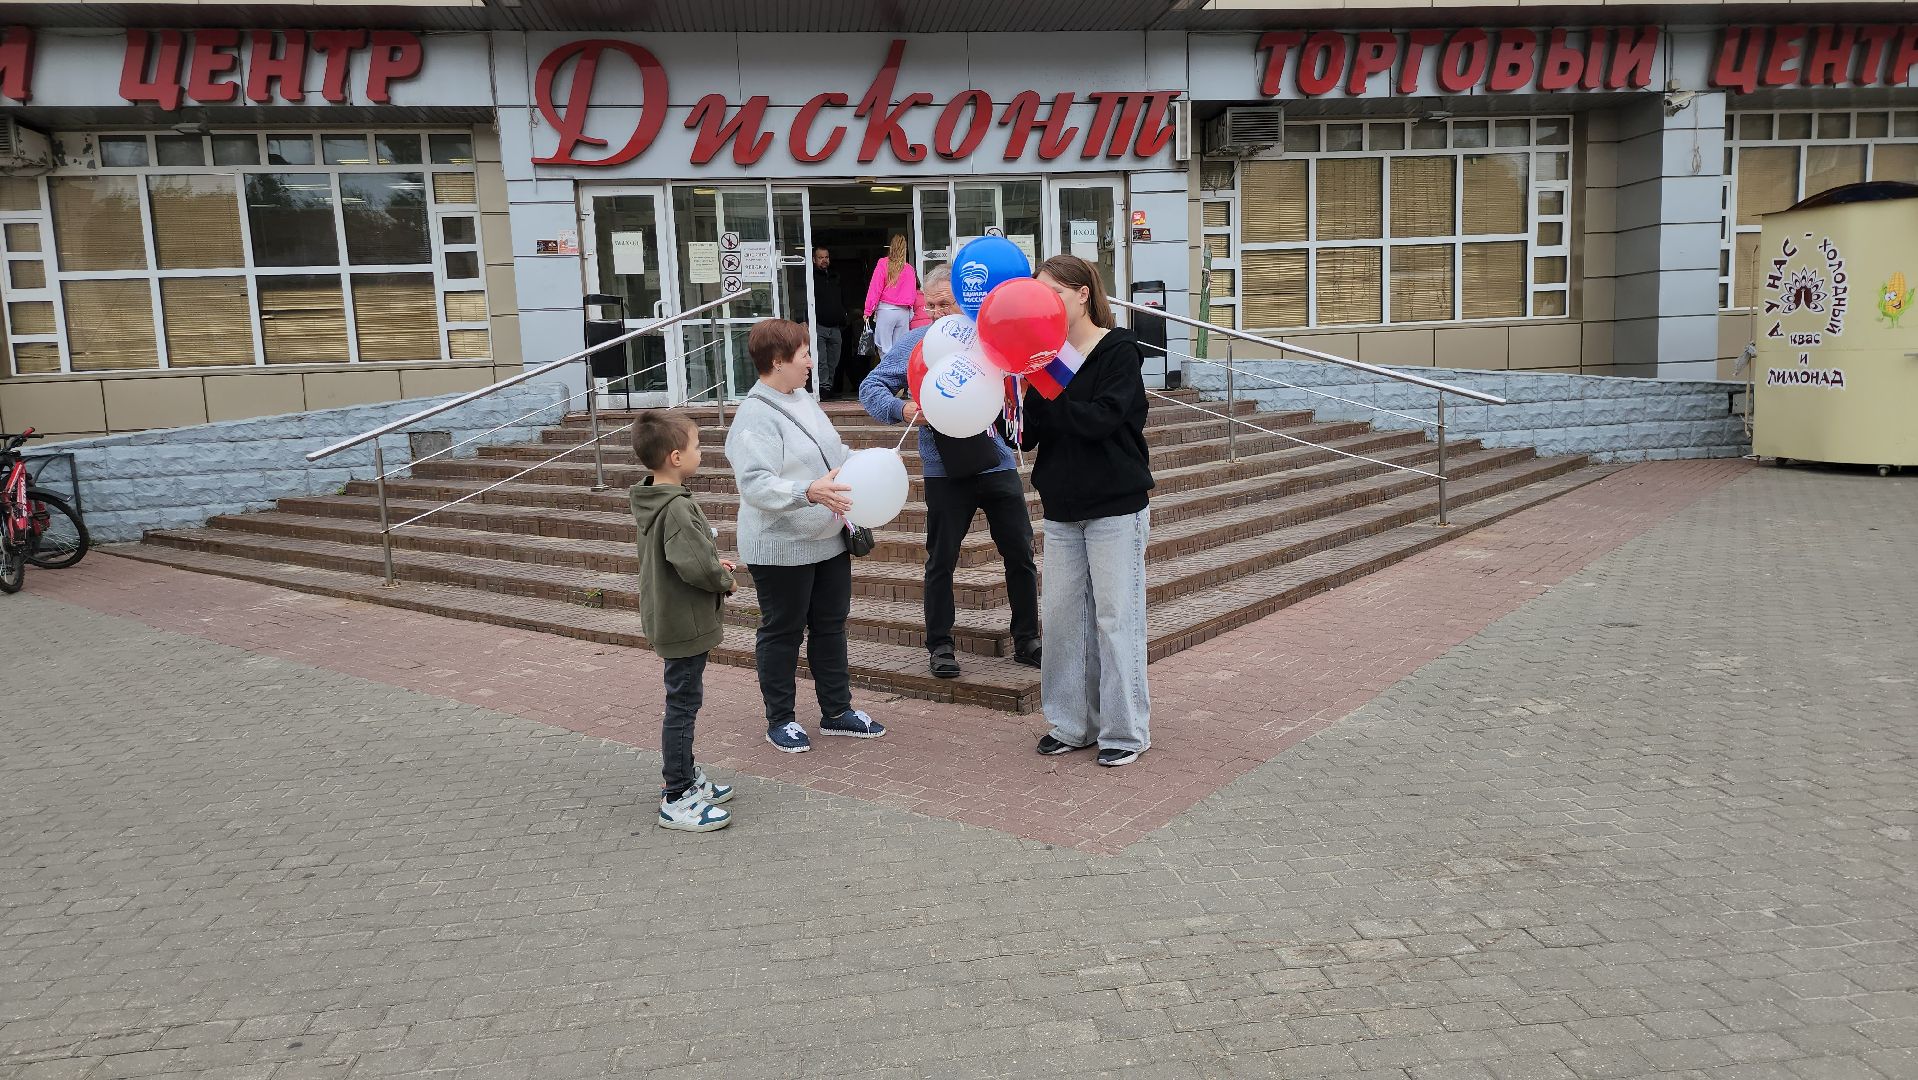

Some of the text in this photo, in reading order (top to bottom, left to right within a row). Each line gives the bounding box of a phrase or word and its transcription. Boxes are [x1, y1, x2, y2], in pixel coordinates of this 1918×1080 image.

[118, 27, 424, 112] ЦЕНТР
[530, 37, 1184, 167] Дисконт
[1767, 369, 1844, 387] ЛИМОНАД
